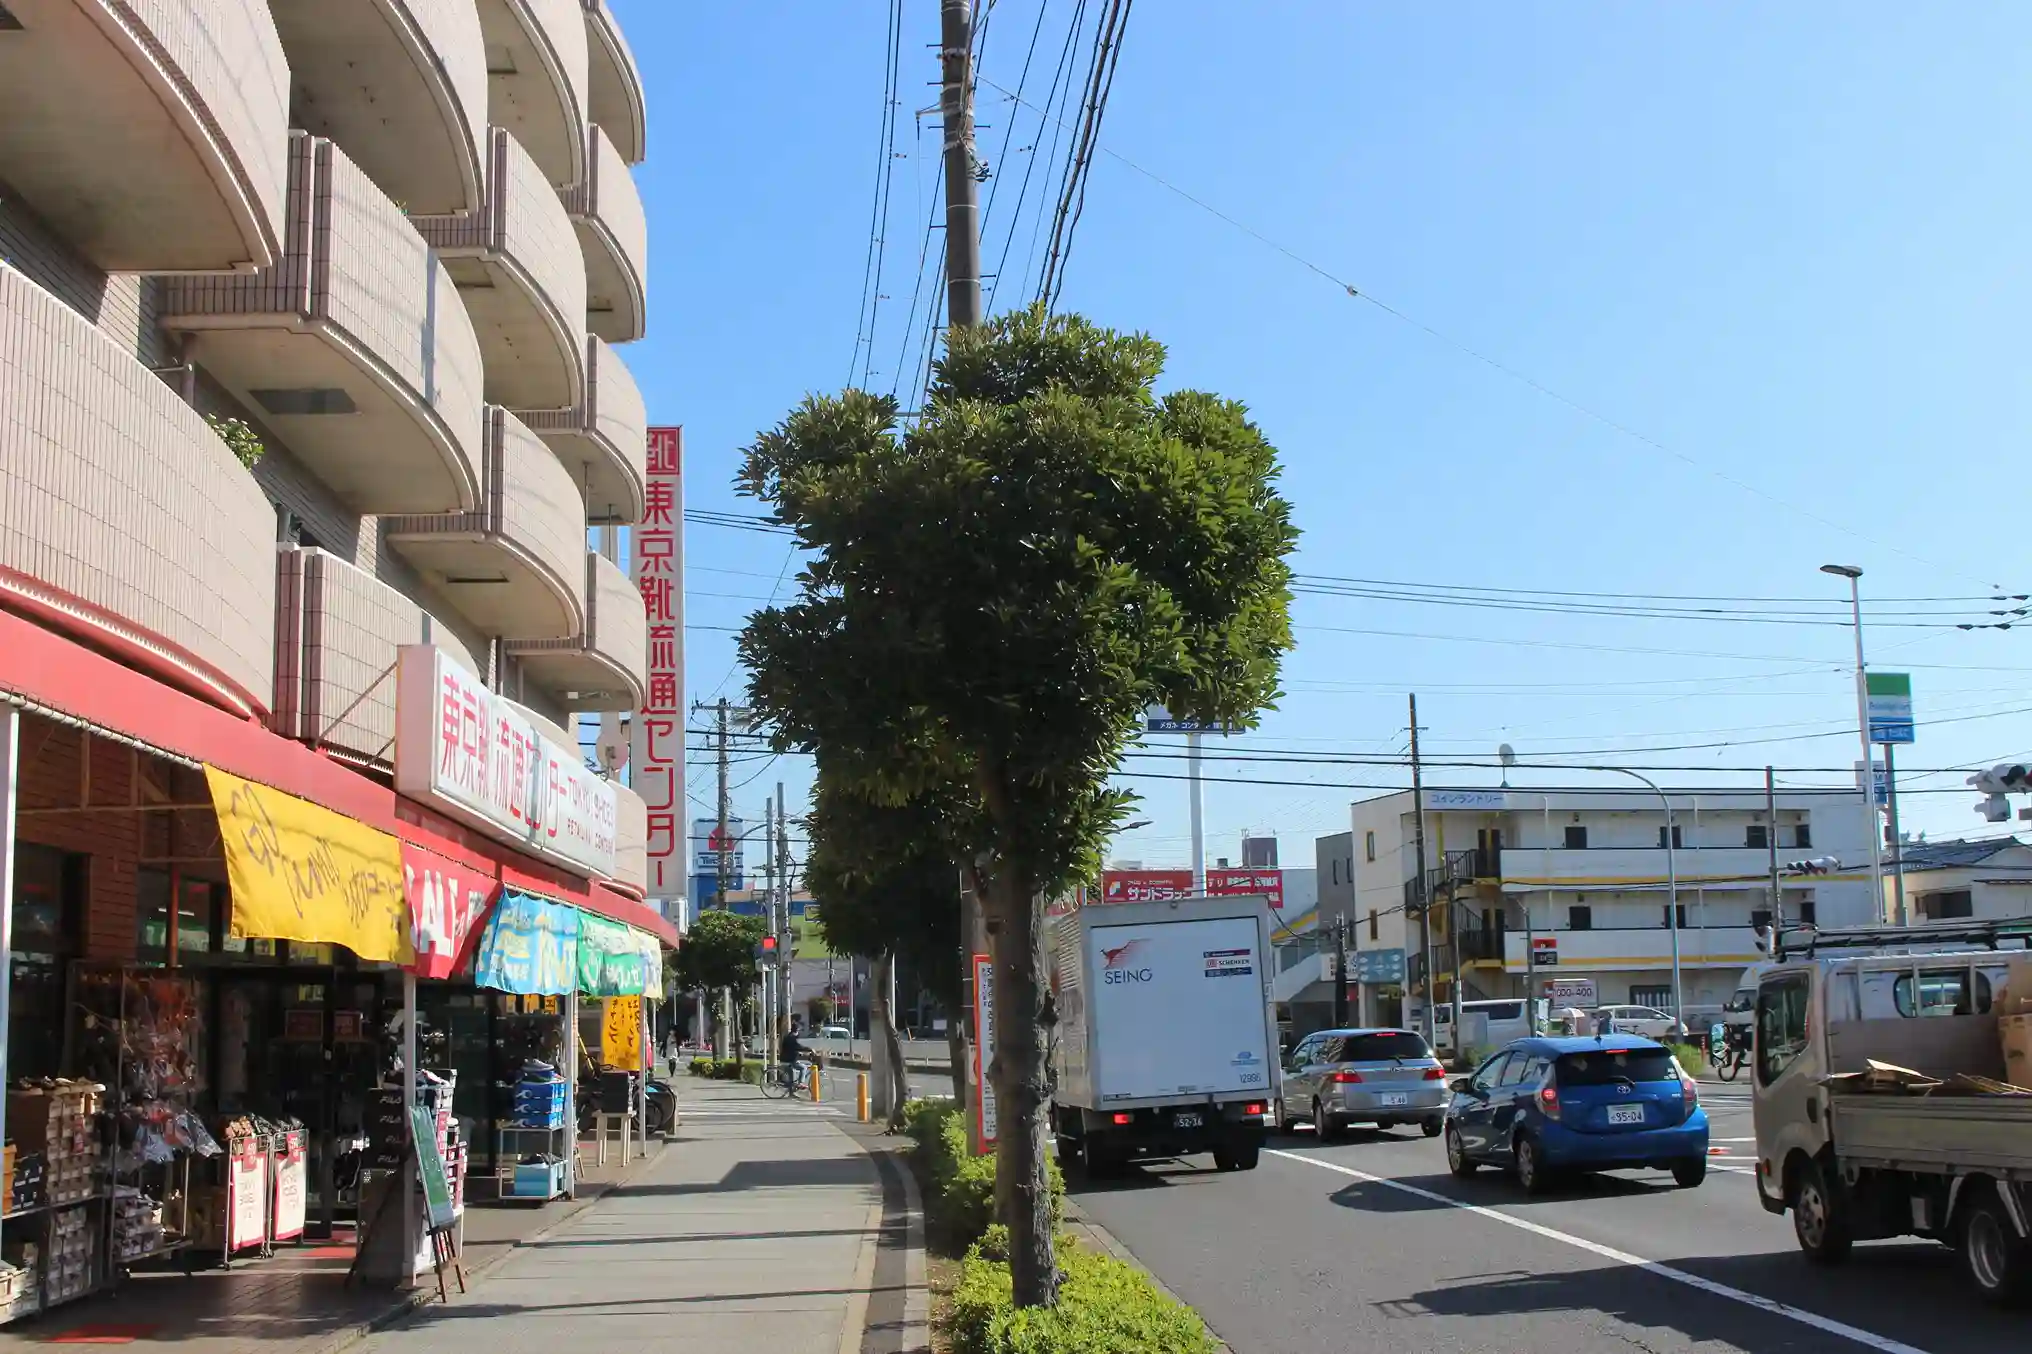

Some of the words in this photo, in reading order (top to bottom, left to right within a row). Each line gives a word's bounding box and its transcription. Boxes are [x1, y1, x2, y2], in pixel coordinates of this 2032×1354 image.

[640, 480, 678, 887] 東京靴流通センター
[1181, 721, 1211, 729] コンタト
[1431, 793, 1504, 805] コインランドリー
